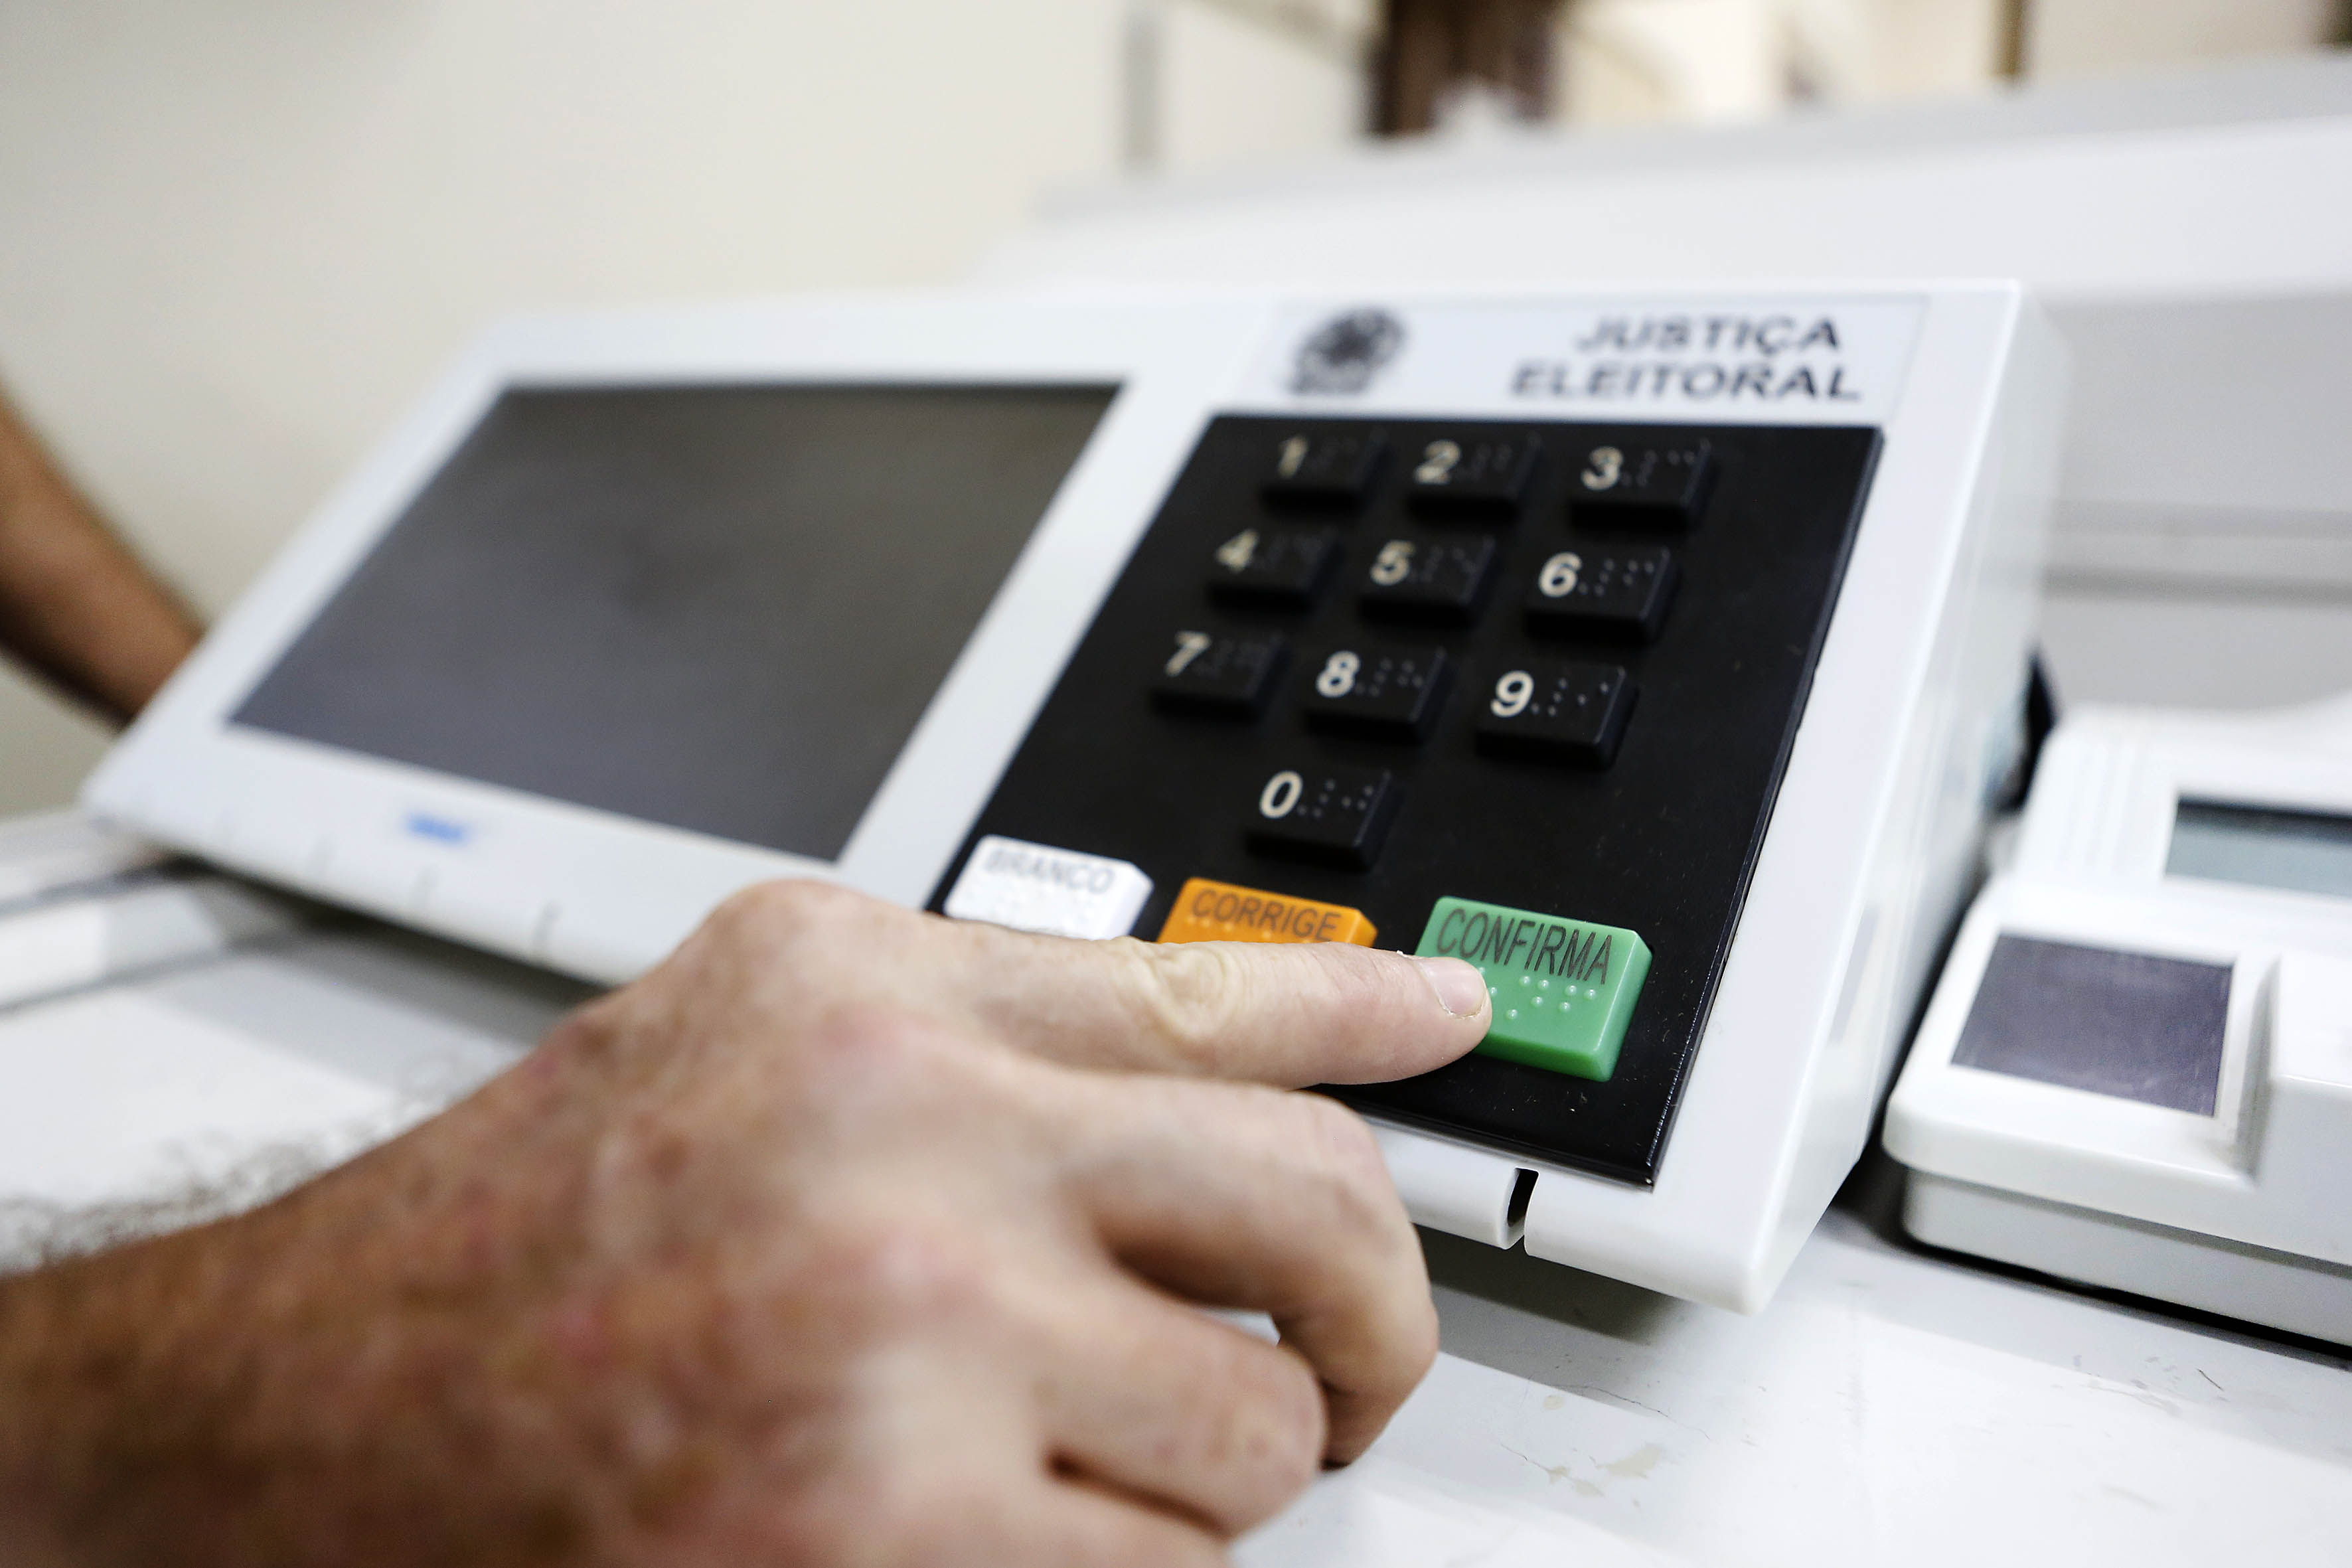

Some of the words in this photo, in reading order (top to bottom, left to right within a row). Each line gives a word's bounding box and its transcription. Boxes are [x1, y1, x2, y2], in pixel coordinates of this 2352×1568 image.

[1573, 314, 1840, 356] JUSTIÇA
[1511, 362, 1861, 401] ELEITORAL
[1279, 436, 1308, 478] 1
[1413, 440, 1460, 485] 2
[1582, 446, 1623, 490] 3
[1217, 530, 1257, 572] 4
[1370, 540, 1415, 585] 5
[1539, 552, 1583, 597] 6
[1166, 631, 1211, 676] 7
[1316, 651, 1360, 697] 8
[1491, 670, 1534, 717] 9
[1259, 770, 1303, 819] 0
[984, 848, 1117, 896] BRANCO
[1191, 888, 1342, 942] CORRIGE
[1437, 908, 1613, 985] CONFIRMA
